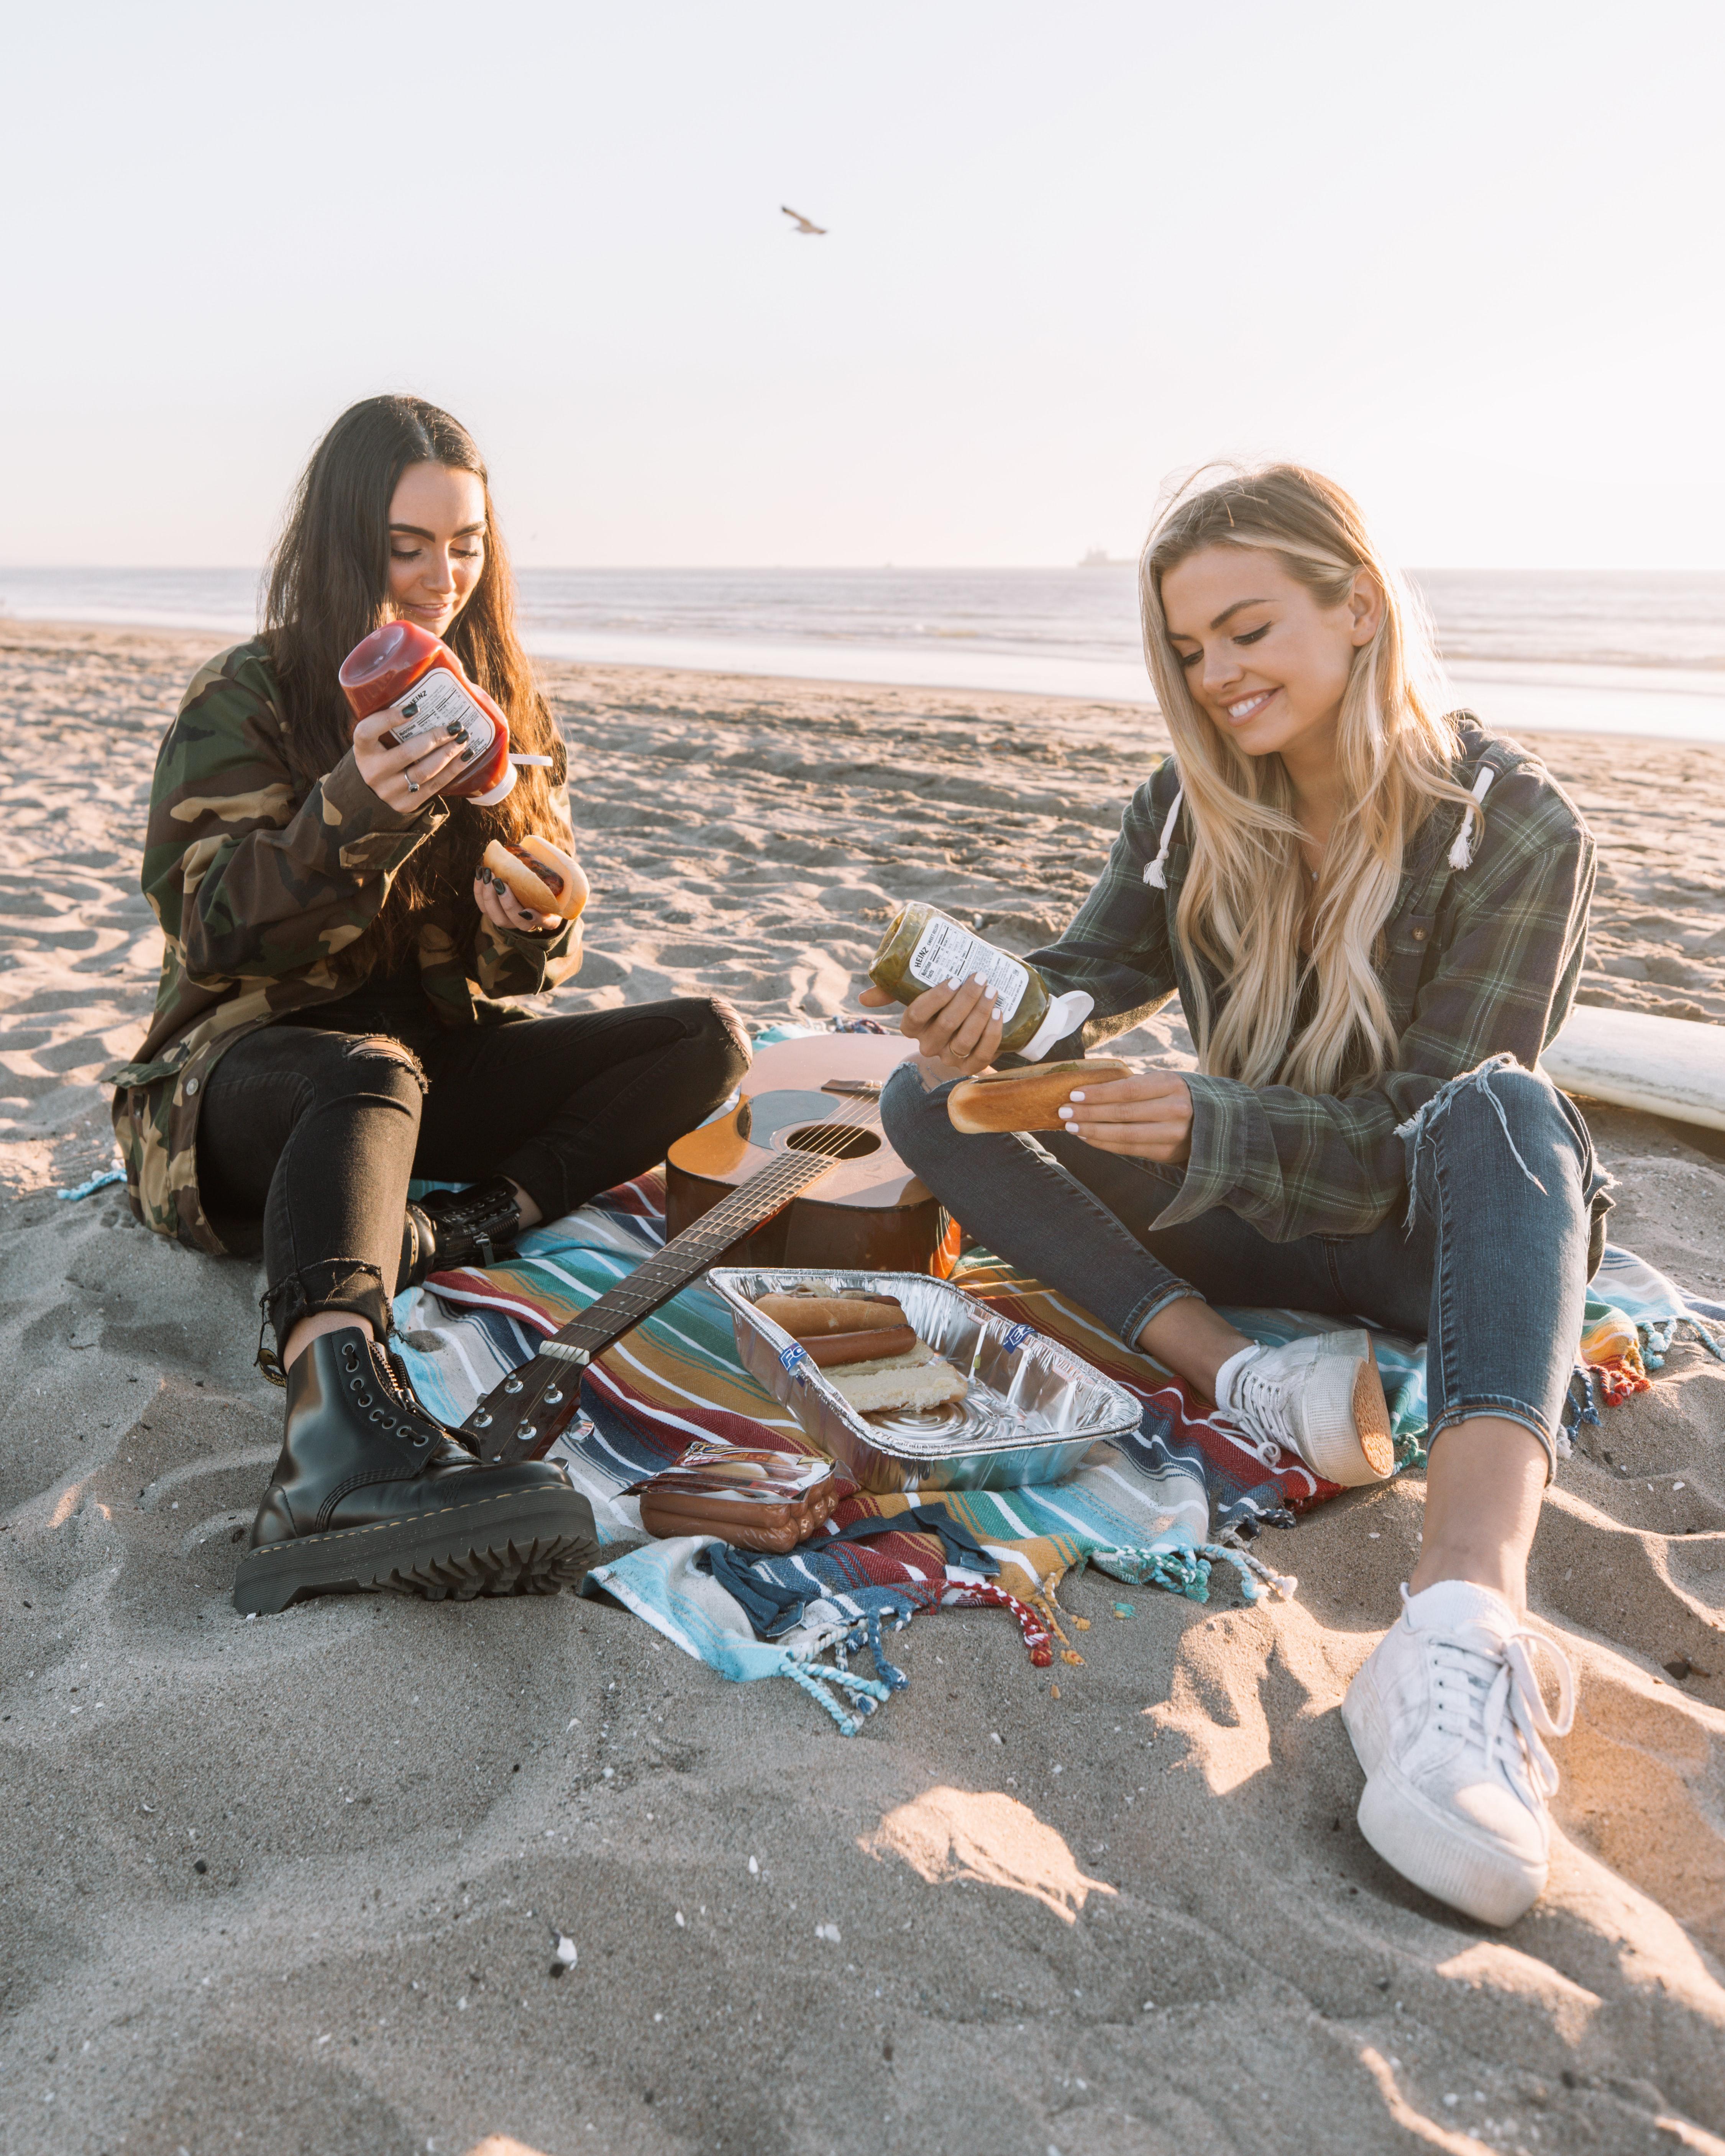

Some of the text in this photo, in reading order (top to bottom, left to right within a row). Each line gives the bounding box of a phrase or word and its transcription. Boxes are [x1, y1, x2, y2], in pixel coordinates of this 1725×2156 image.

[399, 724, 416, 736] Nutrition
[402, 731, 413, 740] Facts
[914, 946, 929, 967] HEINZ
[921, 961, 932, 977] Nutrition
[926, 969, 934, 979] Facts
